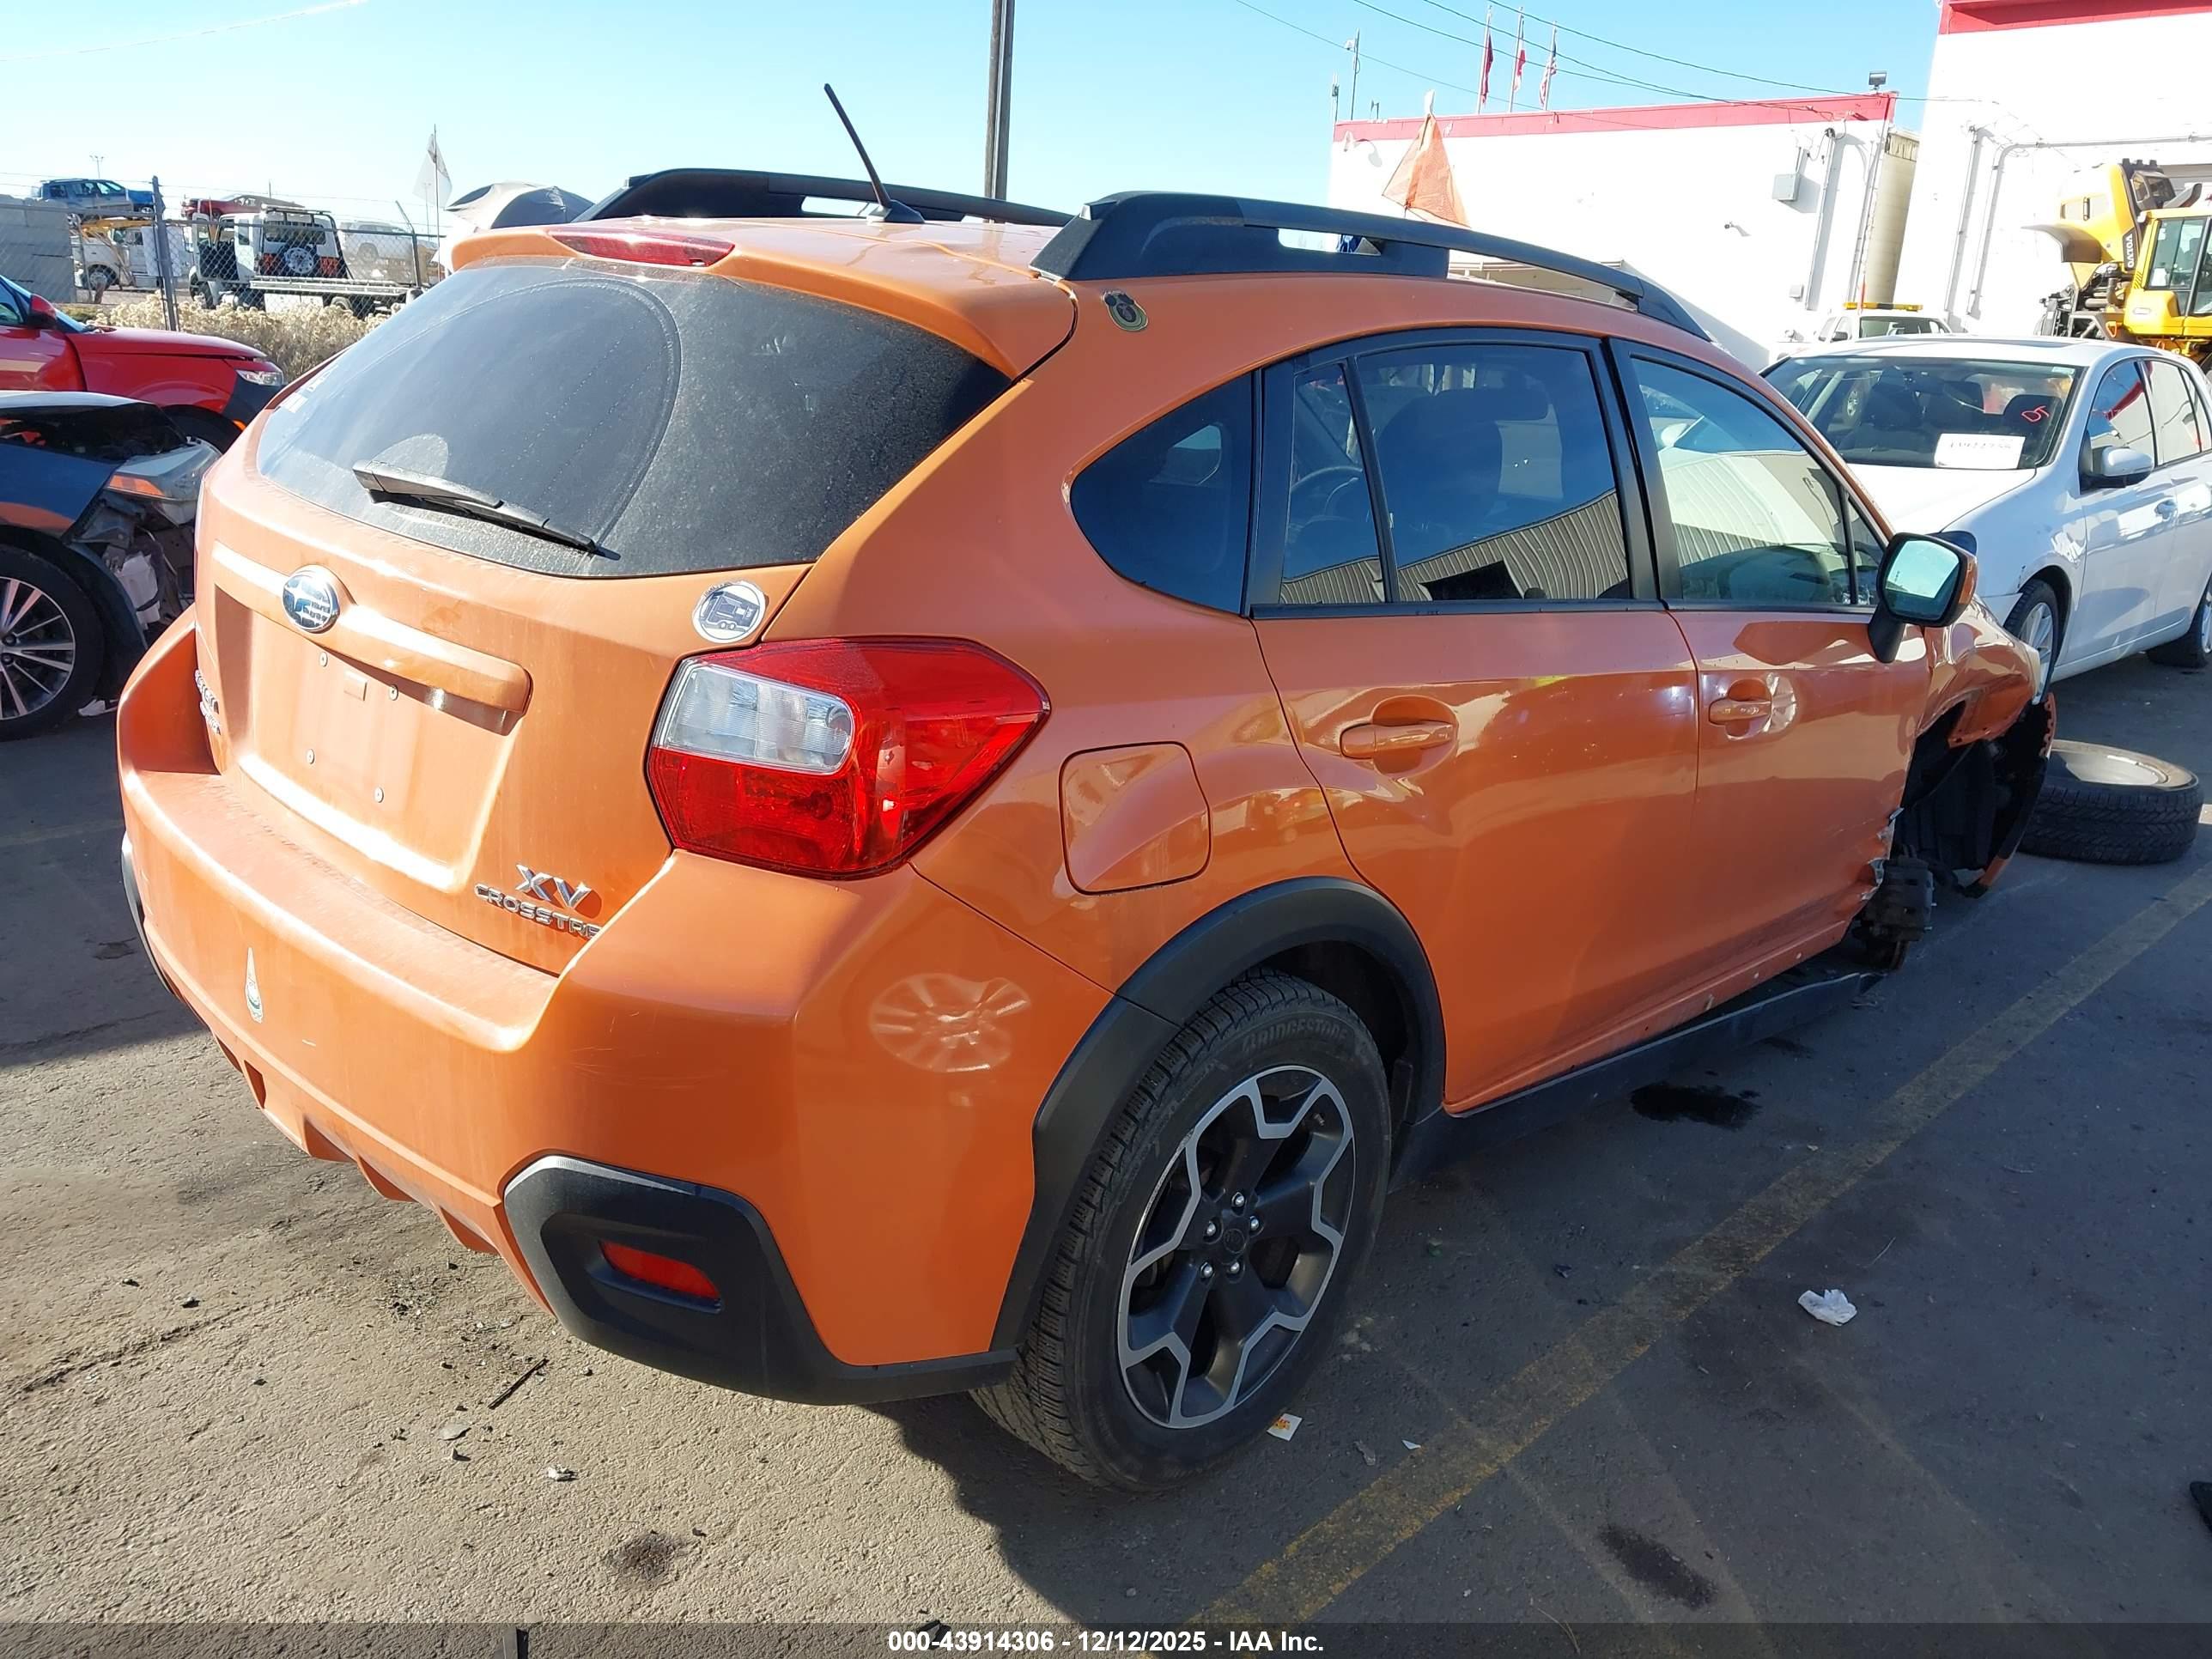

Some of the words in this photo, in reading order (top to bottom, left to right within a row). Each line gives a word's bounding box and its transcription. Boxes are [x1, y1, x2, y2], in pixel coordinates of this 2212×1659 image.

[2125, 233, 2135, 269] VOLVO
[516, 864, 592, 908] XV
[1243, 1018, 1347, 1052] BRIDGESTONE
